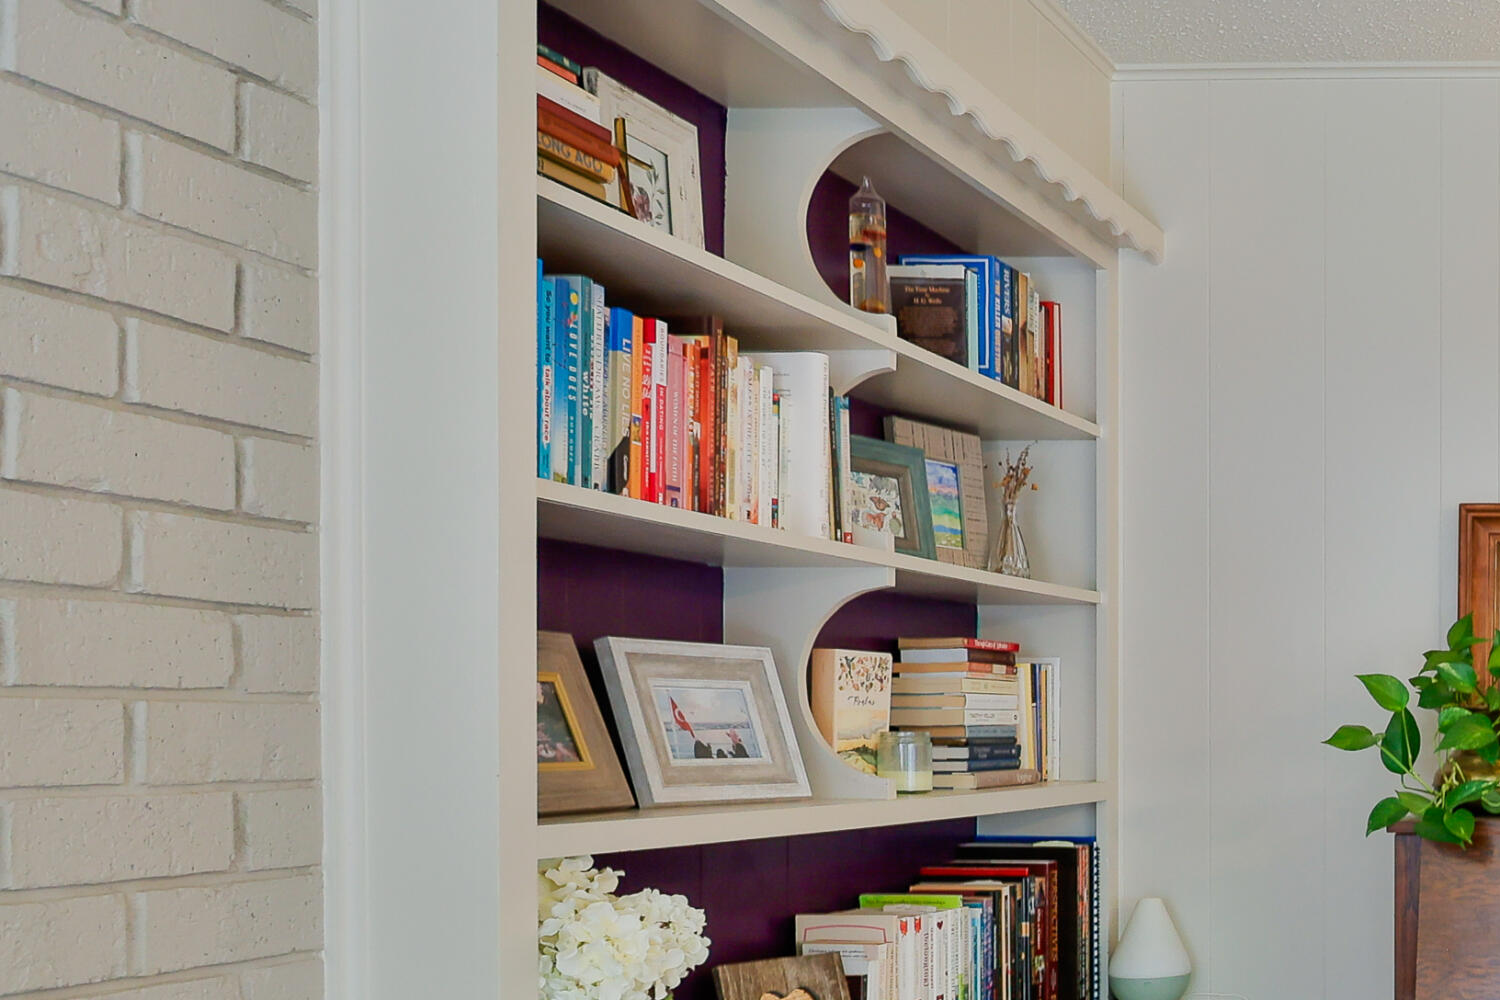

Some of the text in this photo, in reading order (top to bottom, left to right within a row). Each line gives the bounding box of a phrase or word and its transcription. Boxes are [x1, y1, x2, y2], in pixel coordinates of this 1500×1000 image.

[544, 305, 552, 323] you
[1001, 268, 1012, 316] RIVERS
[568, 322, 578, 402] LOVE DOES
[582, 371, 590, 416] white
[621, 337, 632, 437] LIVE NO LIES
[1050, 869, 1059, 963] PERSPECTIVES
